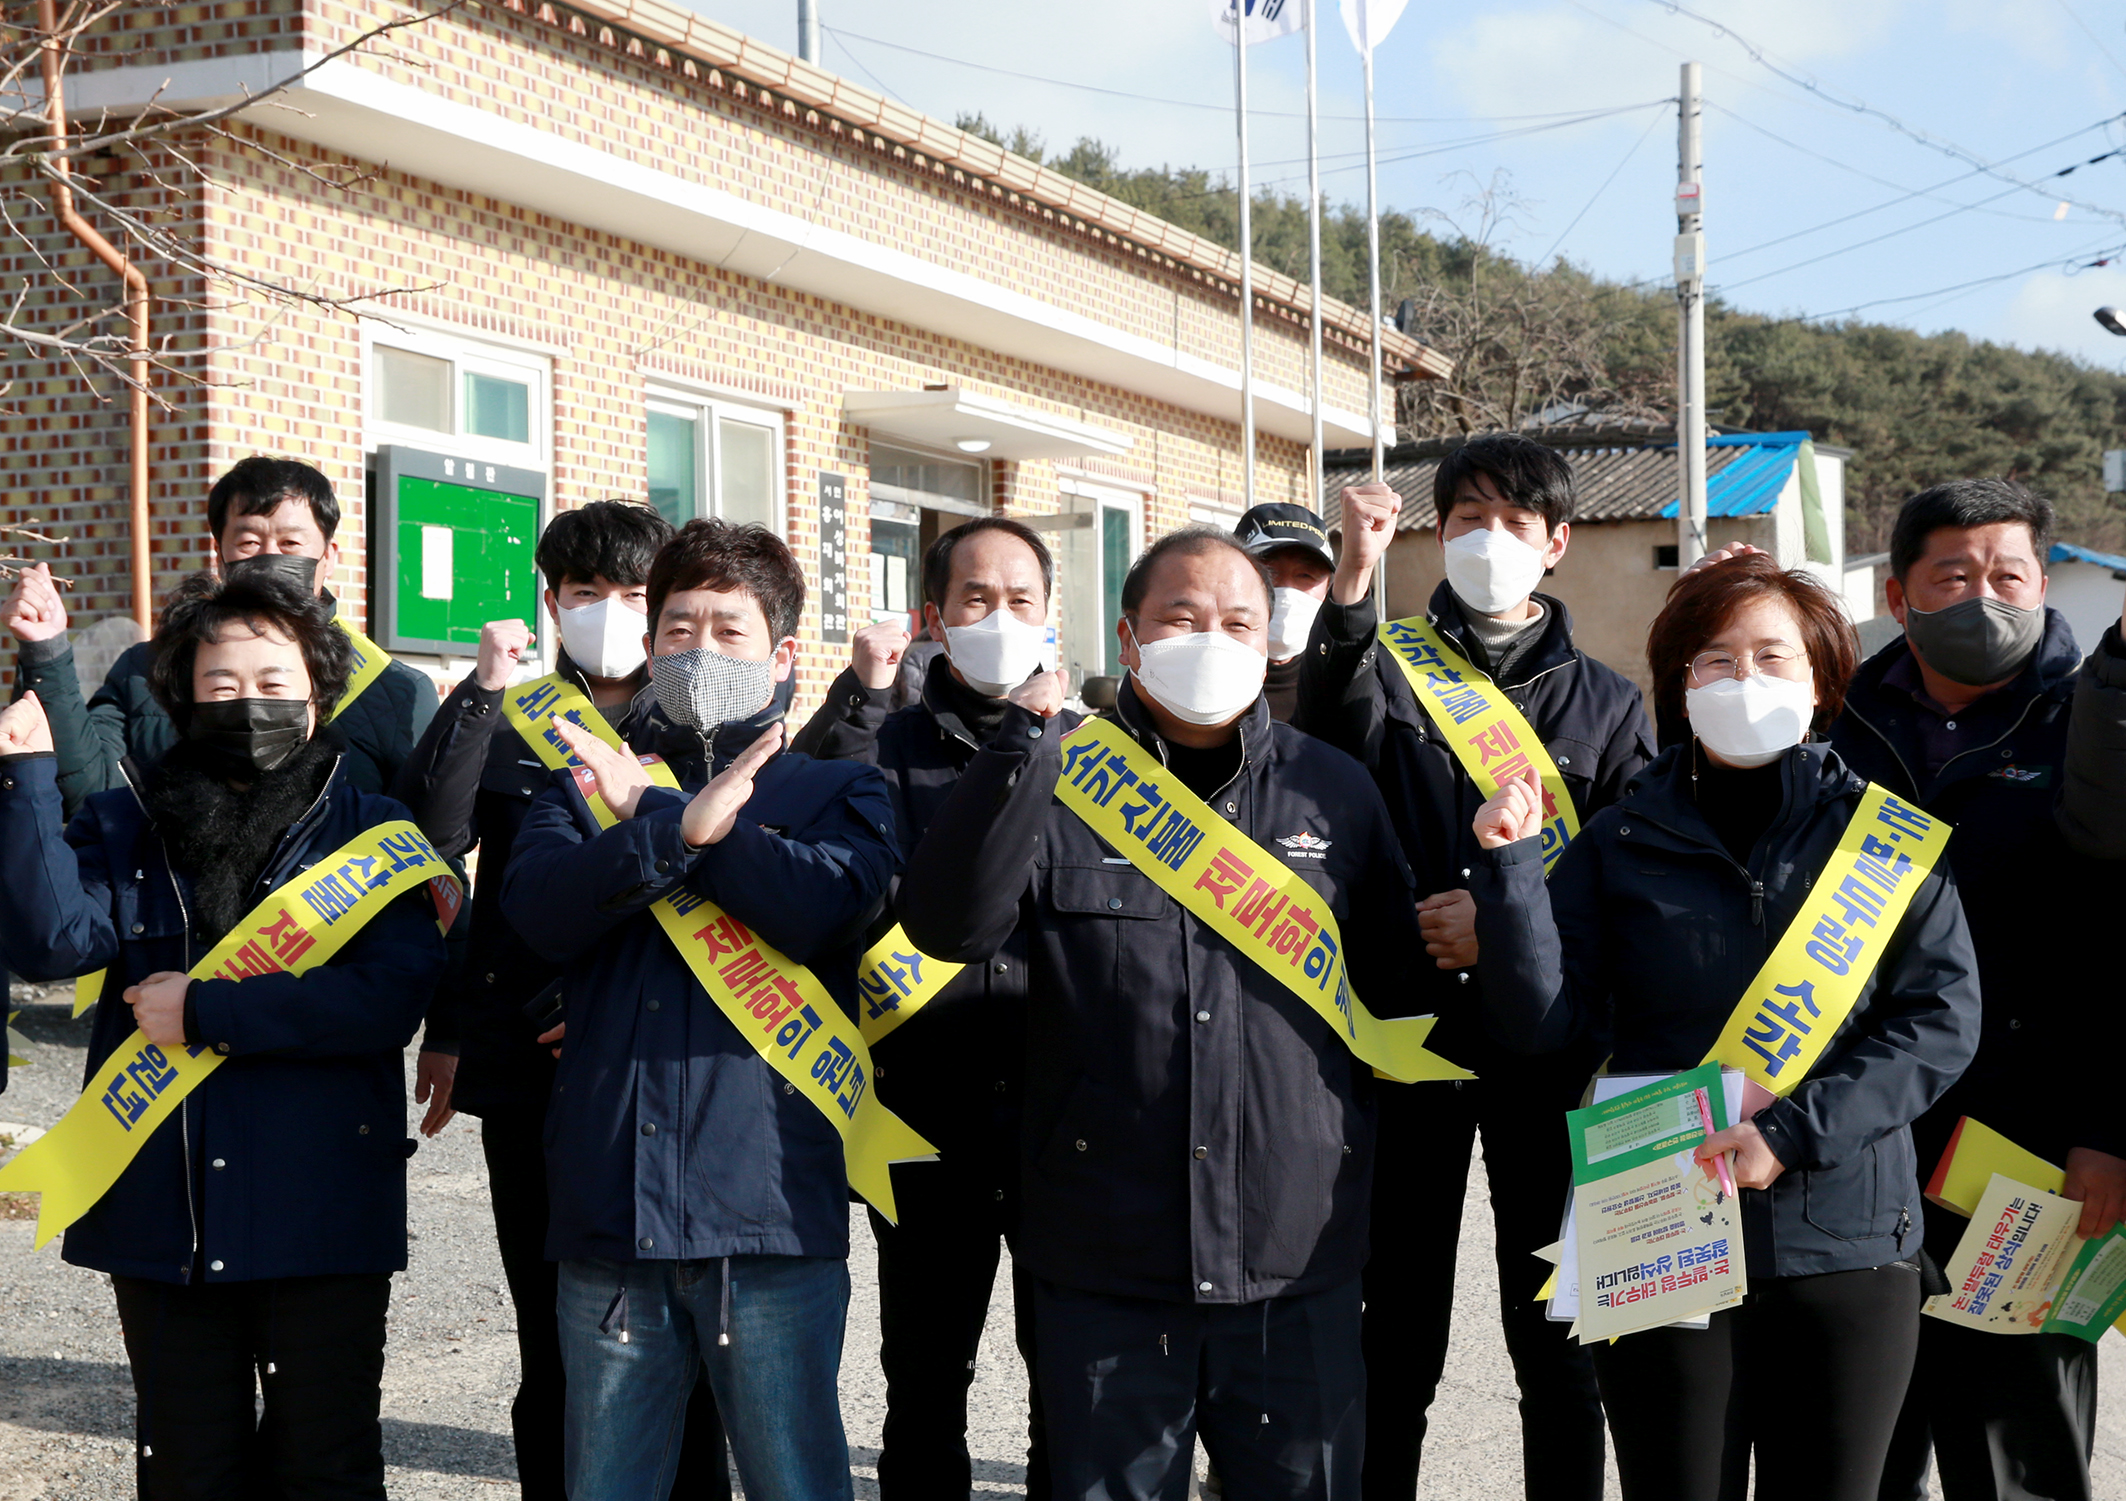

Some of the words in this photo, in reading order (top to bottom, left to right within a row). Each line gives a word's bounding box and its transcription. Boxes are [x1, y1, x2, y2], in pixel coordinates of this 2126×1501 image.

[1386, 622, 1491, 725] 소각산불
[1062, 739, 1205, 871] 소각산불
[1194, 847, 1337, 991] 제로화의
[1287, 850, 1308, 858] FOREST
[1308, 851, 1327, 860] POLICE
[1805, 797, 1931, 976] 논·밭두렁
[692, 908, 824, 1060] 제로화의
[810, 1035, 868, 1120] 원년
[859, 950, 924, 1020] 소각
[1741, 979, 1822, 1078] 소각
[101, 1042, 179, 1132] 원년
[1677, 1238, 1728, 1268] 잘못된
[1967, 1272, 2003, 1314] 잘못된
[1994, 1202, 2042, 1269] 상식입니다!
[1986, 1197, 2024, 1249] 태우기는
[1596, 1255, 1672, 1289] 상식입니다!
[1597, 1280, 1656, 1307] 태우기는
